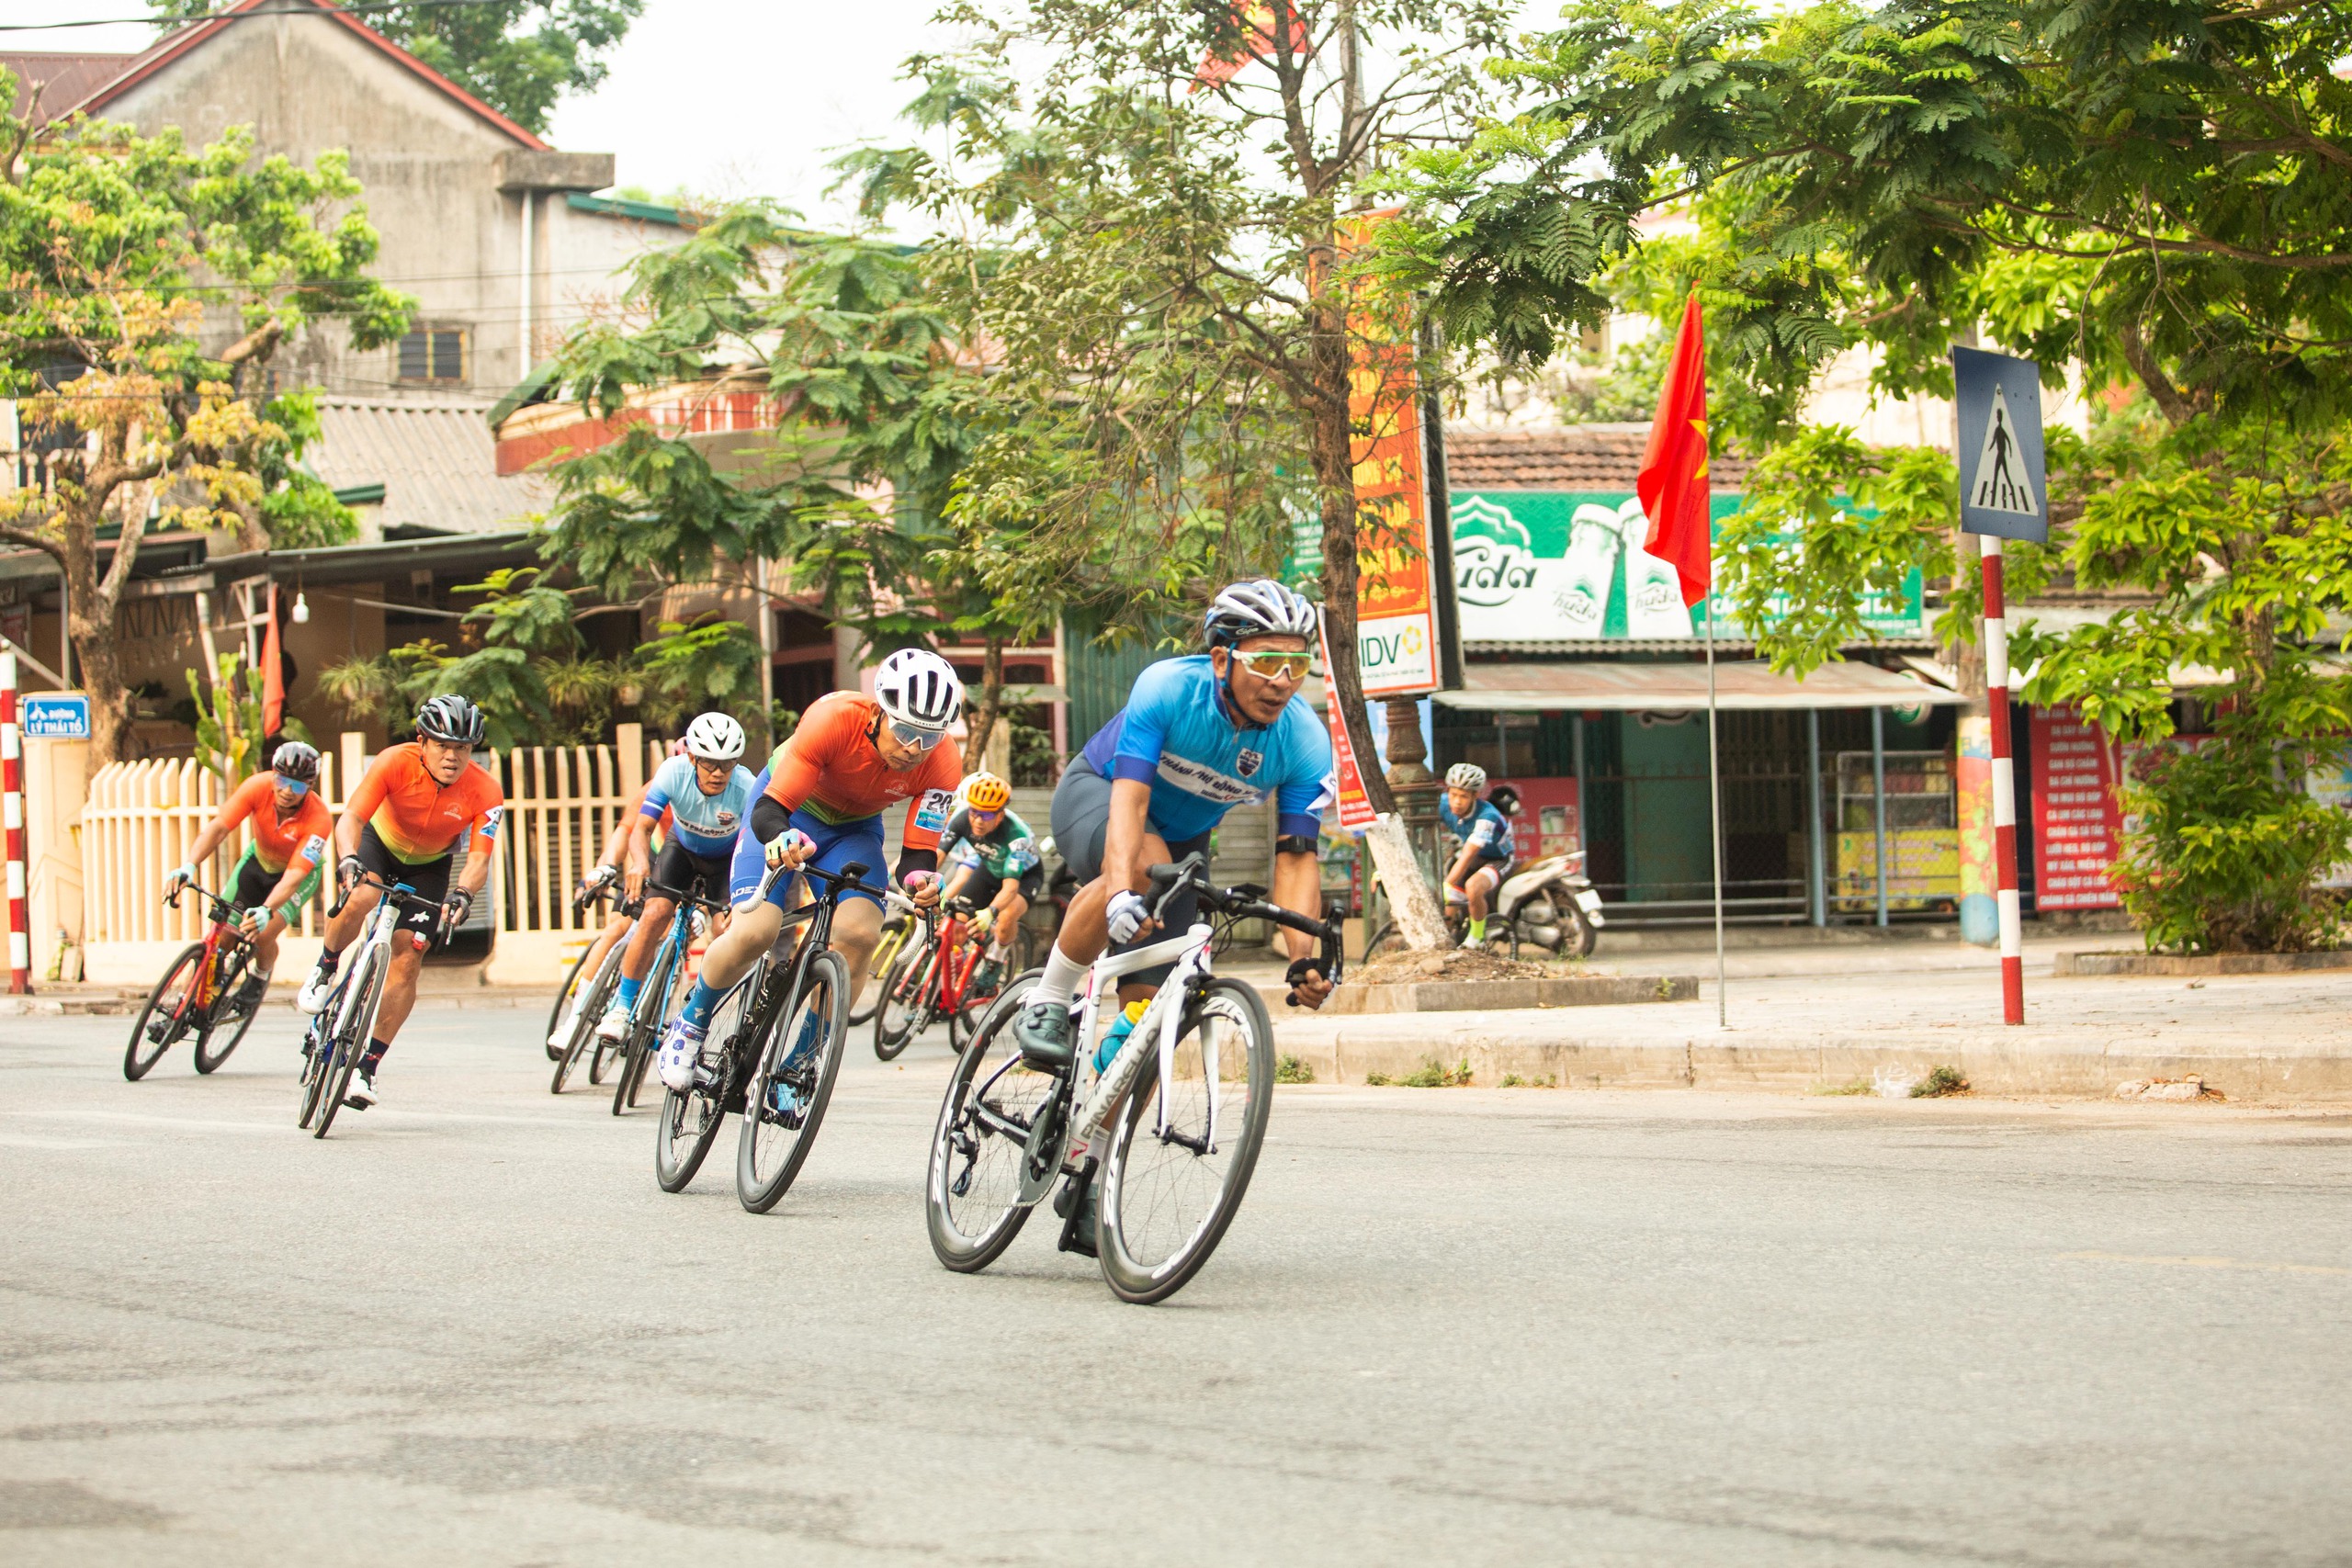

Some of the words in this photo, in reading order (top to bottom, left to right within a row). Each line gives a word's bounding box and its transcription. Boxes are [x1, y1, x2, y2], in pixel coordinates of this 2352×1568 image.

[1455, 549, 1538, 589] uda
[1361, 633, 1401, 668] IDV
[30, 719, 42, 734] LÝ
[43, 719, 68, 733] THÁI
[69, 716, 84, 733] TỔ
[1159, 755, 1193, 775] THÀNH
[1080, 1027, 1159, 1140] PINARELLO
